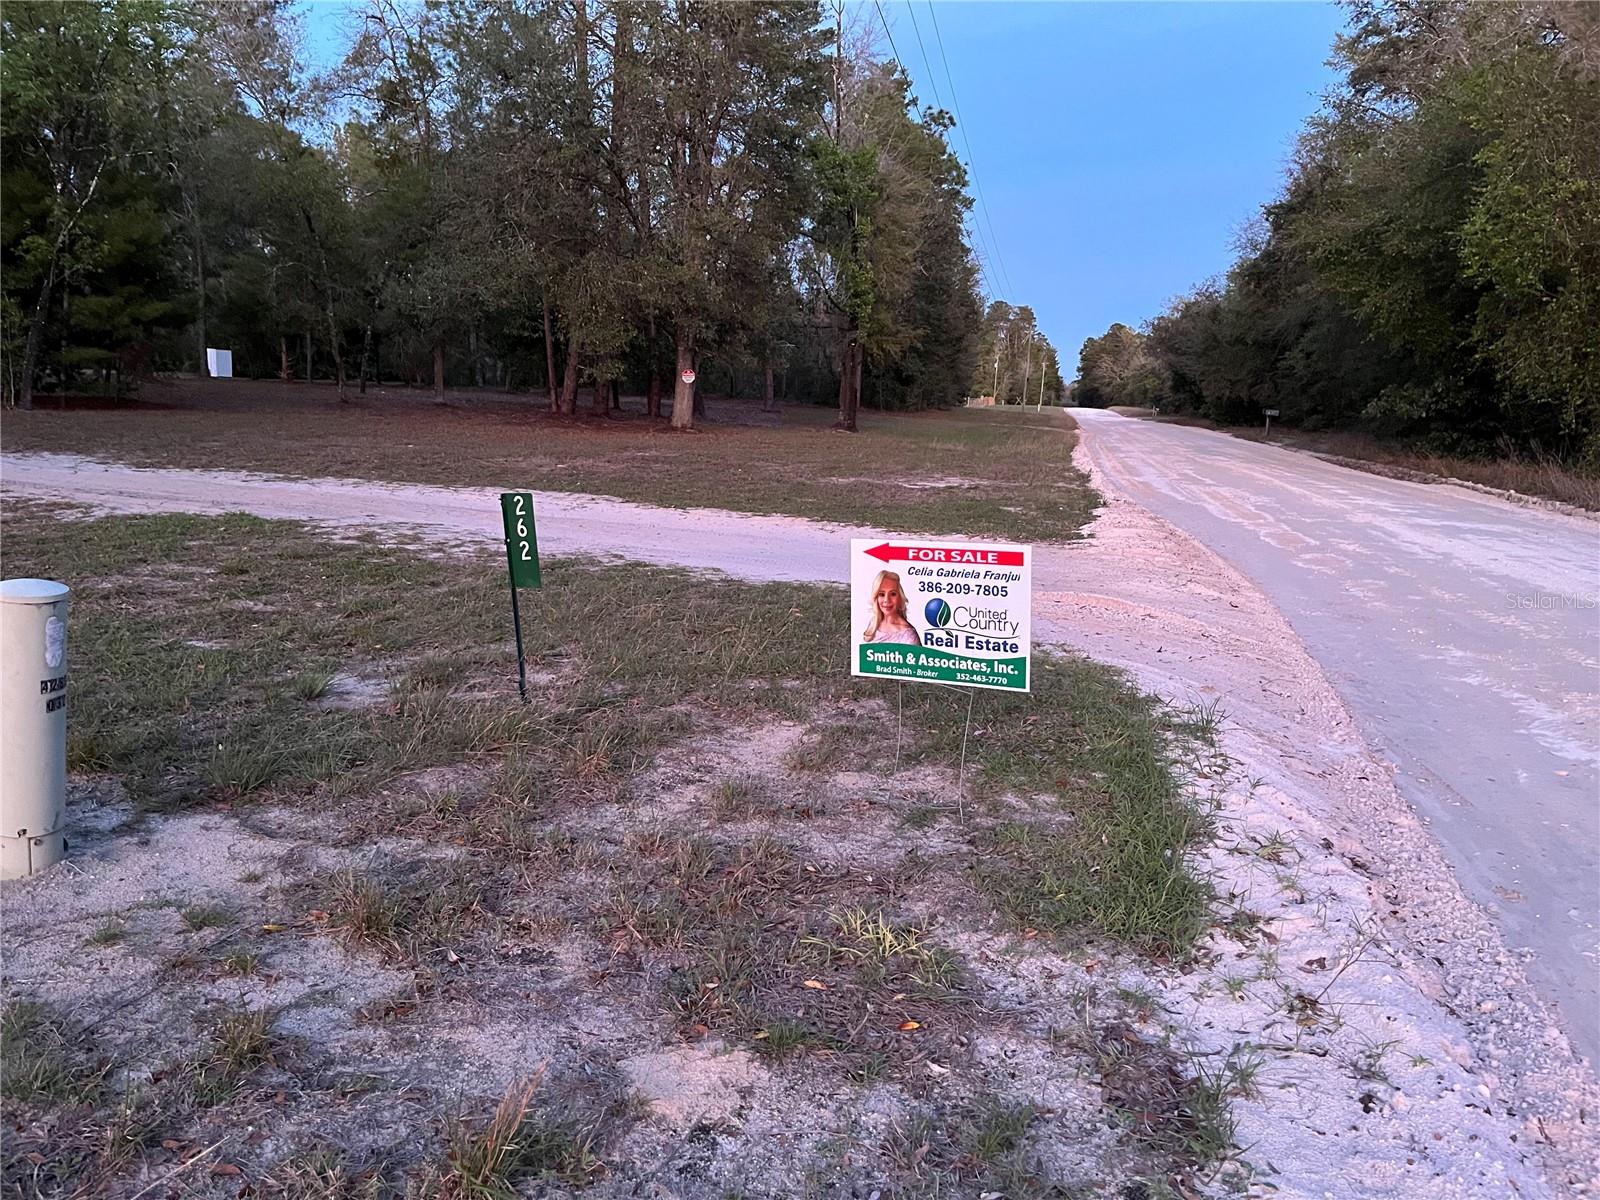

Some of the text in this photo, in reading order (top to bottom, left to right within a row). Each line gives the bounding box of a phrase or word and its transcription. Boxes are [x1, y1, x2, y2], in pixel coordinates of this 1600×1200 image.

[513, 495, 532, 561] 262
[908, 548, 998, 564] FOR SALE
[907, 566, 934, 577] Celia
[936, 567, 981, 580] Gabriela
[918, 581, 1009, 598] 386-209-7805
[953, 606, 1019, 635] Country
[968, 606, 1007, 621] United
[924, 632, 1019, 653] Real Estate
[866, 649, 1019, 675] Smith & Associates, Inc.
[876, 664, 892, 673] Brad
[892, 665, 912, 675] Smith
[916, 668, 938, 678] Broker
[956, 672, 1008, 685] 352-463-7770
